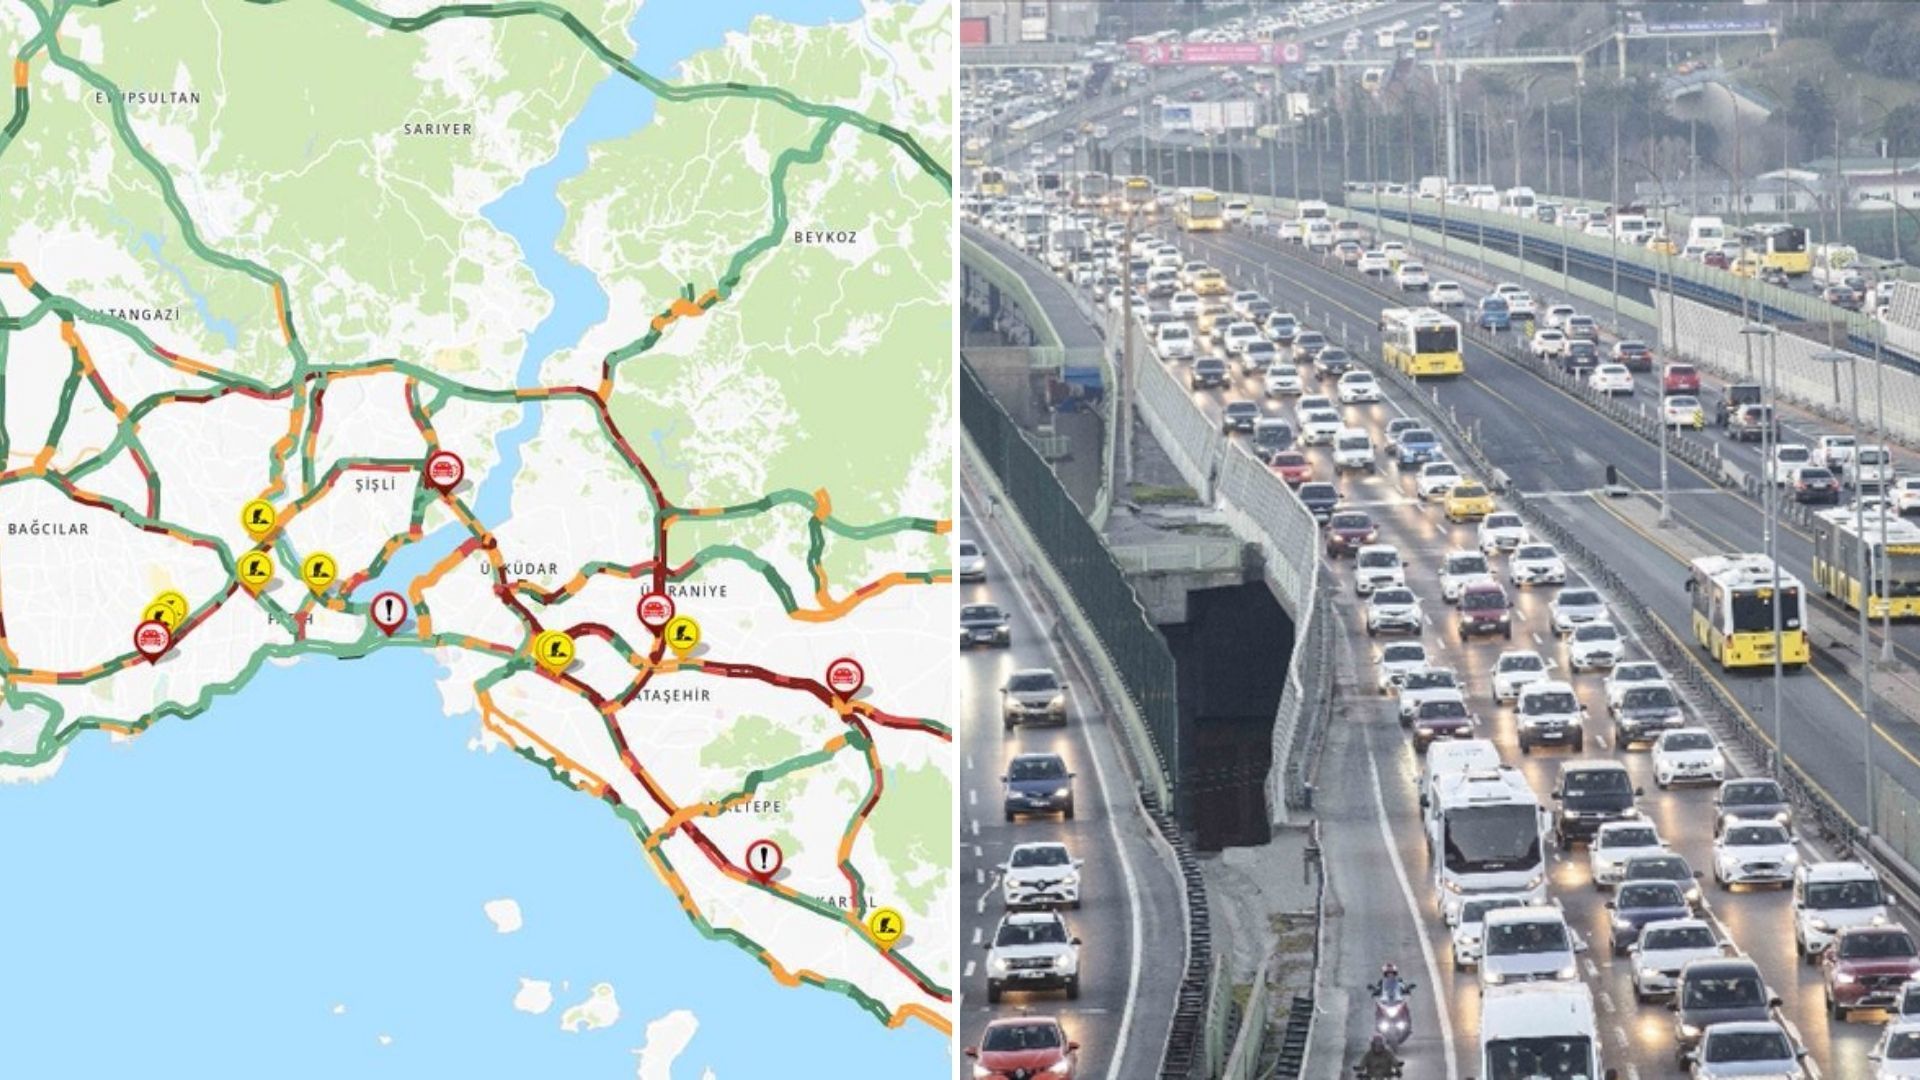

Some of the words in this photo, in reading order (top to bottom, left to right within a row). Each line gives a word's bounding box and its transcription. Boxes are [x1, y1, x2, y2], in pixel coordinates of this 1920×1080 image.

[96, 92, 200, 104] EPSULTAN
[404, 123, 472, 135] SARIYER
[794, 231, 857, 243] BEYKOZ
[355, 478, 395, 492] ŞİŞLİ
[8, 519, 89, 535] BAĞCILAR
[480, 560, 558, 575] ÜKÜDAR
[640, 582, 727, 597] ÜRANİYE
